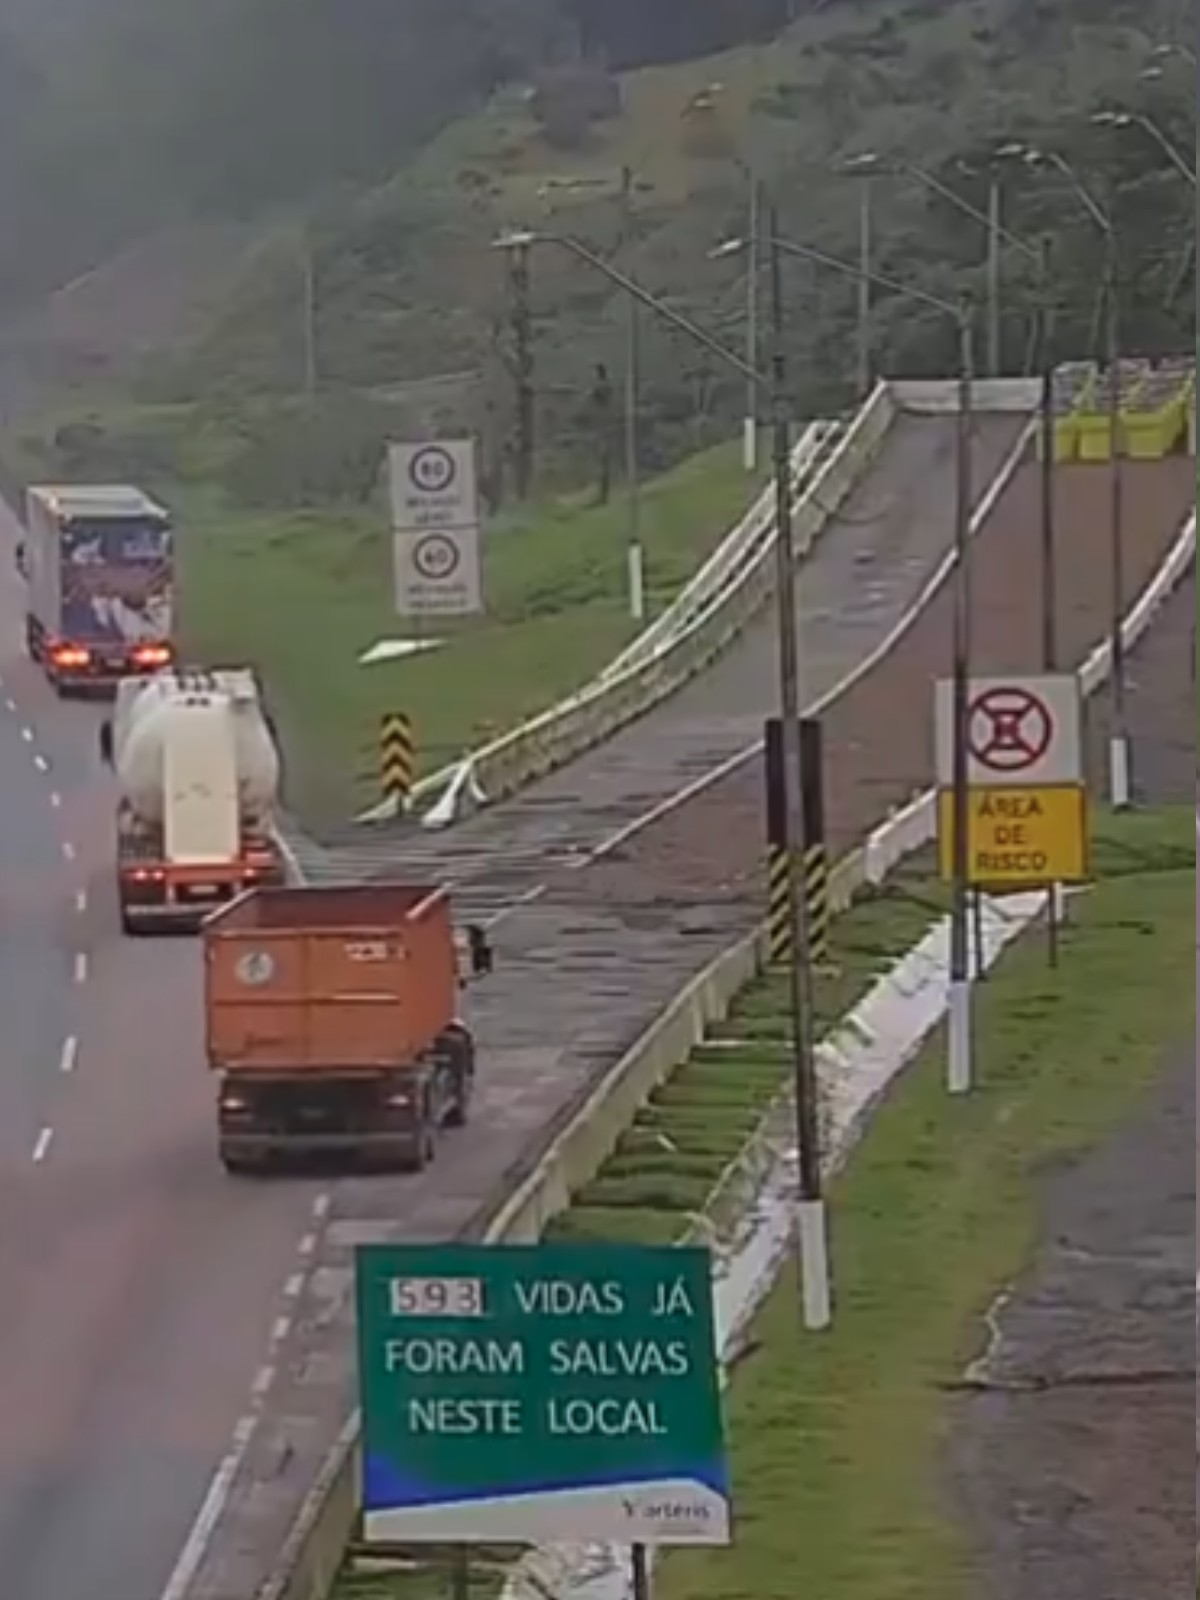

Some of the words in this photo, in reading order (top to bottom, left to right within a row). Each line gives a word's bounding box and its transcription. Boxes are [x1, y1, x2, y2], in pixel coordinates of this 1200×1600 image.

[978, 794, 1043, 818] ÁREA
[994, 825, 1026, 845] DE
[976, 853, 1047, 871] RISCO
[397, 1281, 479, 1313] 593
[514, 1281, 623, 1314] VIDAS
[650, 1275, 693, 1316] JÁ
[385, 1341, 523, 1373] FORAM
[550, 1341, 688, 1374] SALVAS
[410, 1401, 521, 1433] NESTE
[549, 1400, 668, 1433] LOCAL
[643, 1502, 711, 1519] arteris
